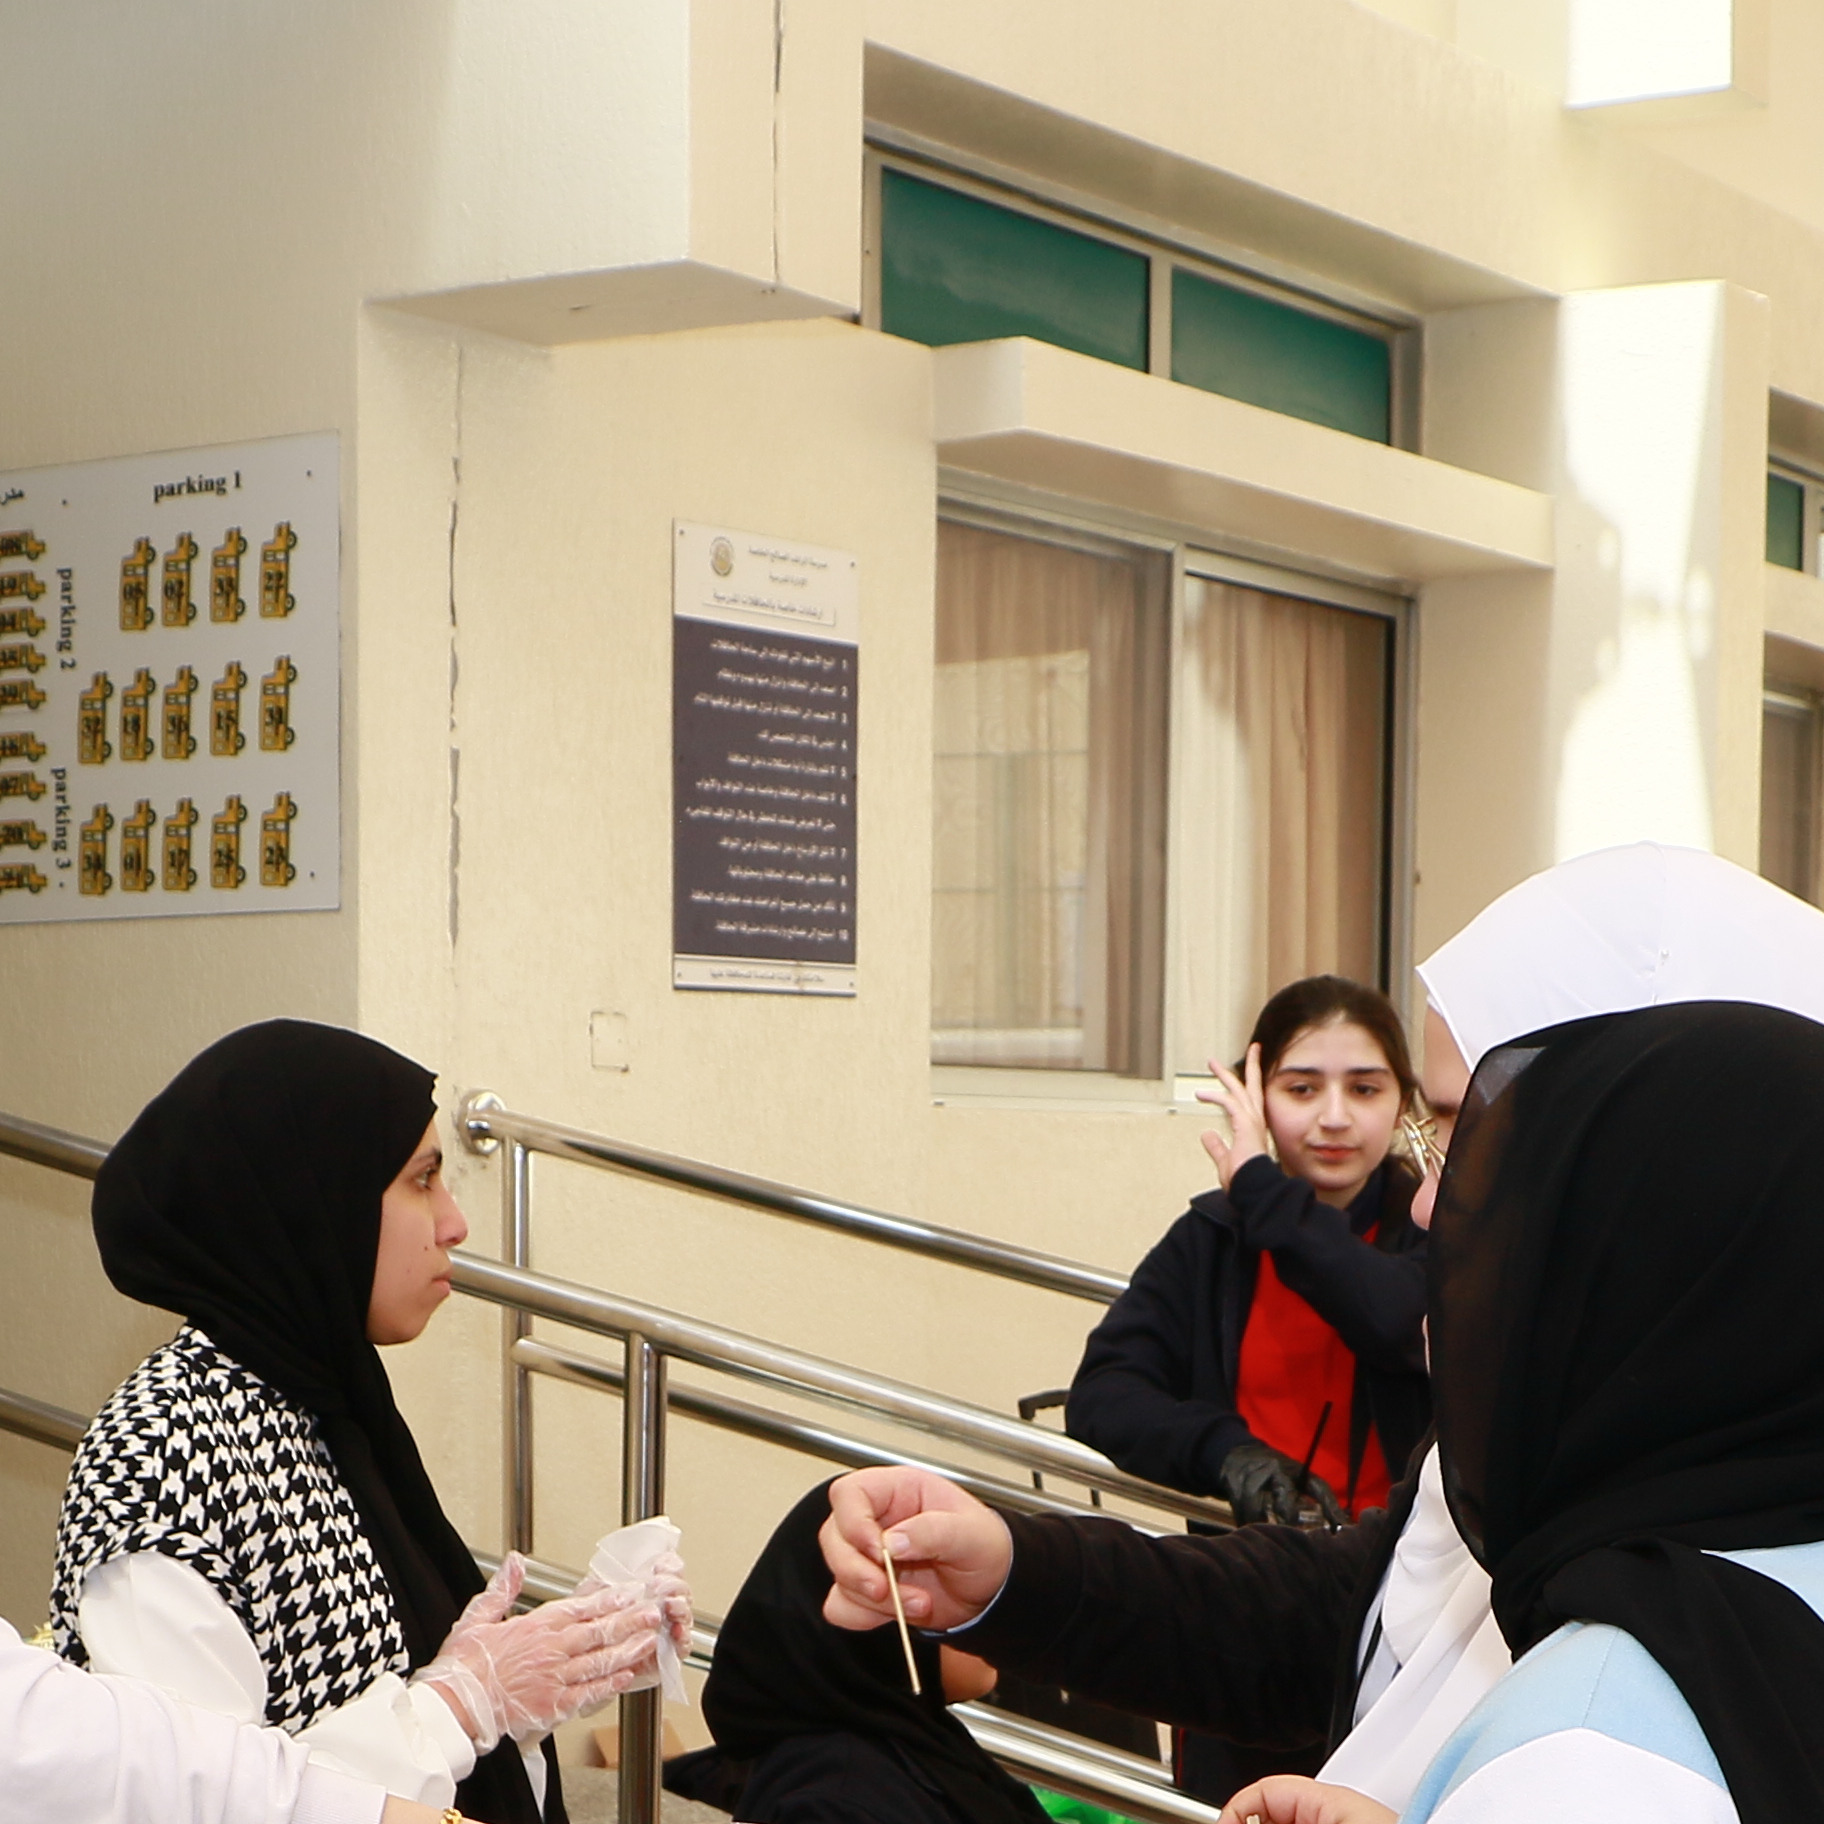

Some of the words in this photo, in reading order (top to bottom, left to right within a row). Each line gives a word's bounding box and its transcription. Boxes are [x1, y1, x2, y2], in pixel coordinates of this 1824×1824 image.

[154, 475, 228, 502] parking
[233, 469, 242, 490] 1
[57, 567, 76, 652] parking
[60, 657, 76, 671] 2
[50, 767, 72, 852] parking
[56, 857, 72, 869] 3
